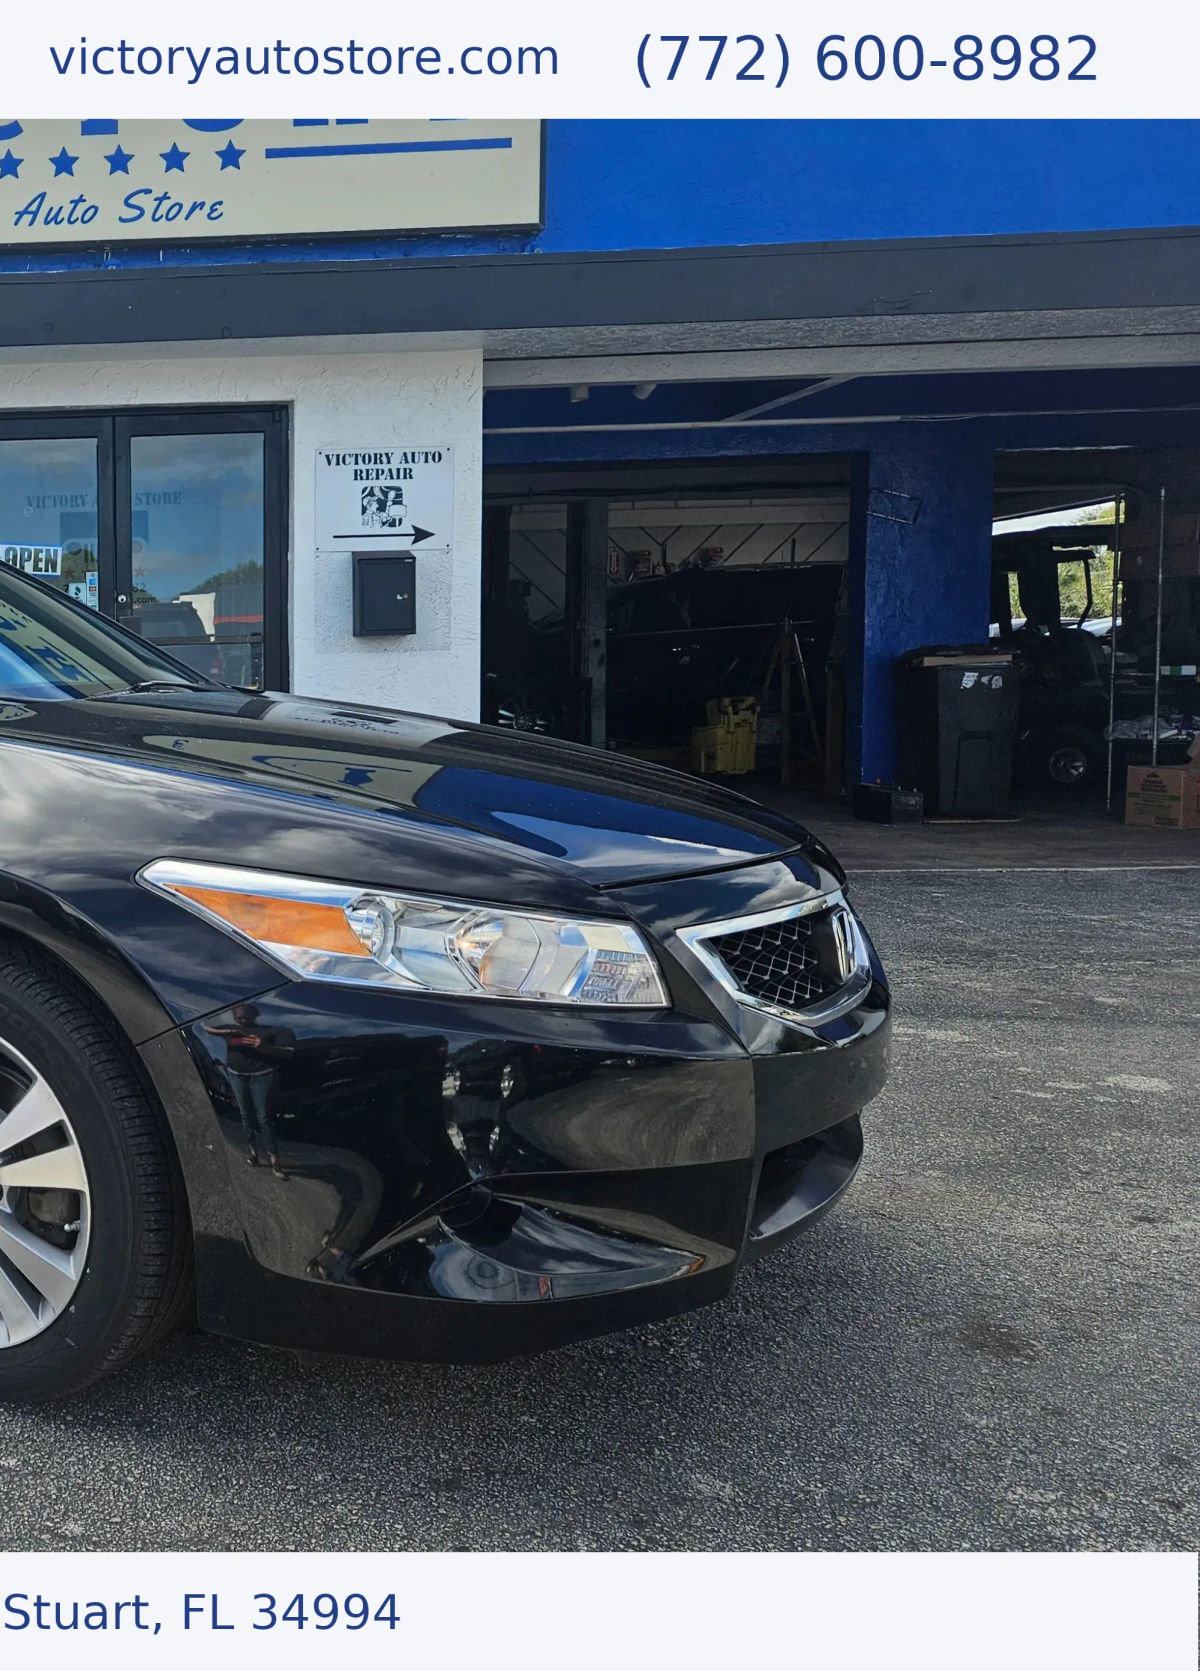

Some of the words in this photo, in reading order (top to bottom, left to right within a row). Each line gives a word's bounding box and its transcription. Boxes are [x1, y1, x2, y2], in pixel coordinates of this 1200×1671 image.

[13, 191, 99, 227] Auto
[118, 188, 224, 223] Store
[324, 452, 394, 467] VICTORY
[399, 450, 443, 465] AUTO
[353, 467, 414, 481] REPAIR
[4, 546, 59, 574] OPEN
